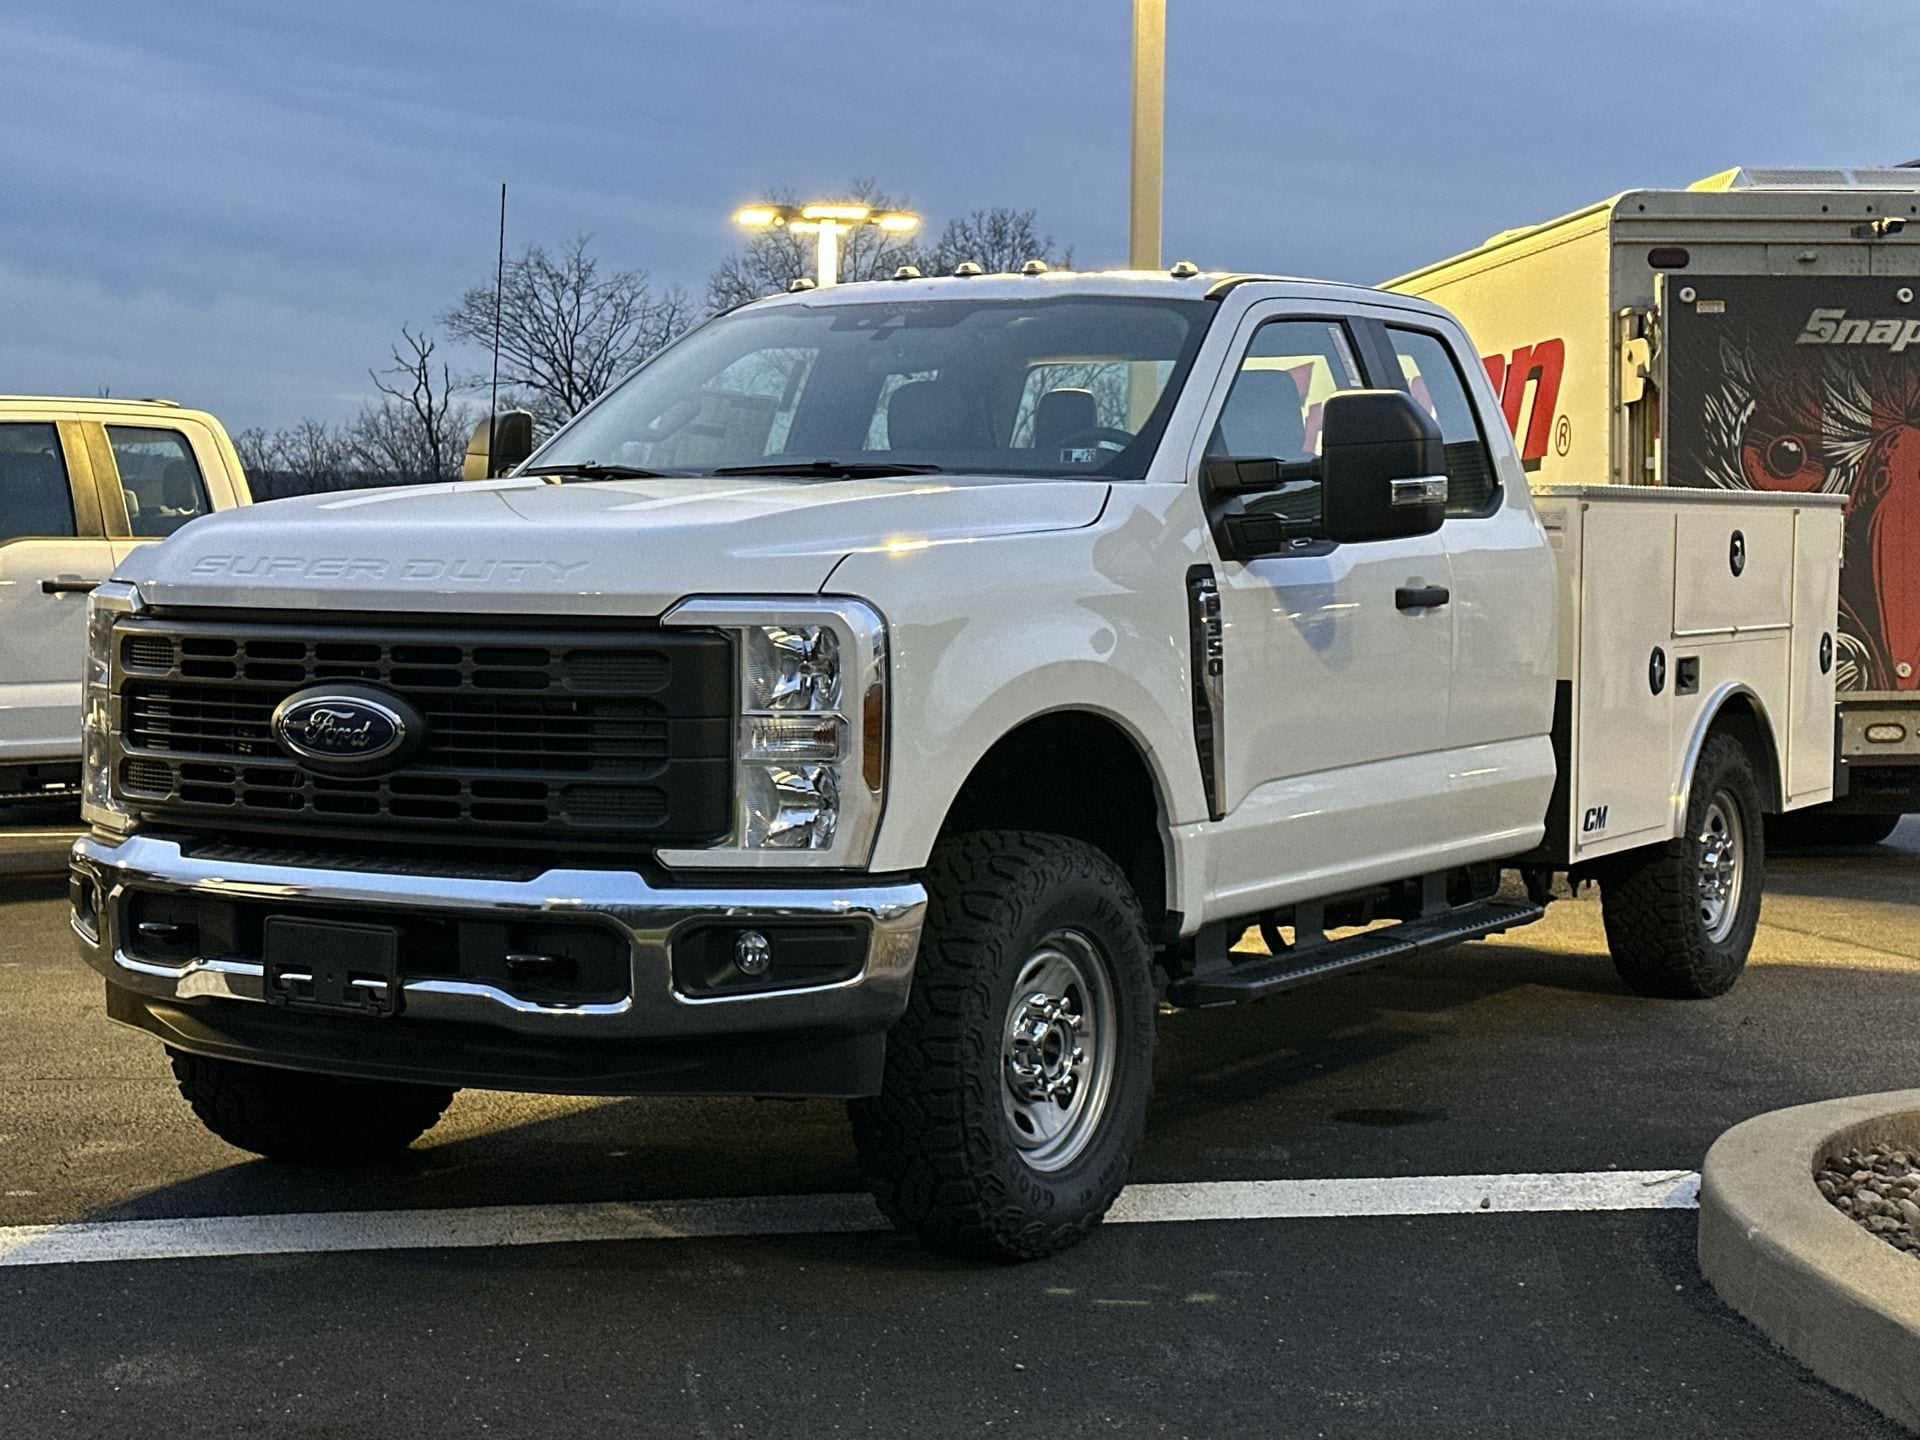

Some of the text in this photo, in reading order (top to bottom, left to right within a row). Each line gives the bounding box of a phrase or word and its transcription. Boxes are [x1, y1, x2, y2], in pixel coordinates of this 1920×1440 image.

[1795, 308, 1920, 351] Snap
[190, 555, 592, 582] SUPER DUTY
[305, 708, 372, 747] Ford
[1583, 805, 1608, 831] CM
